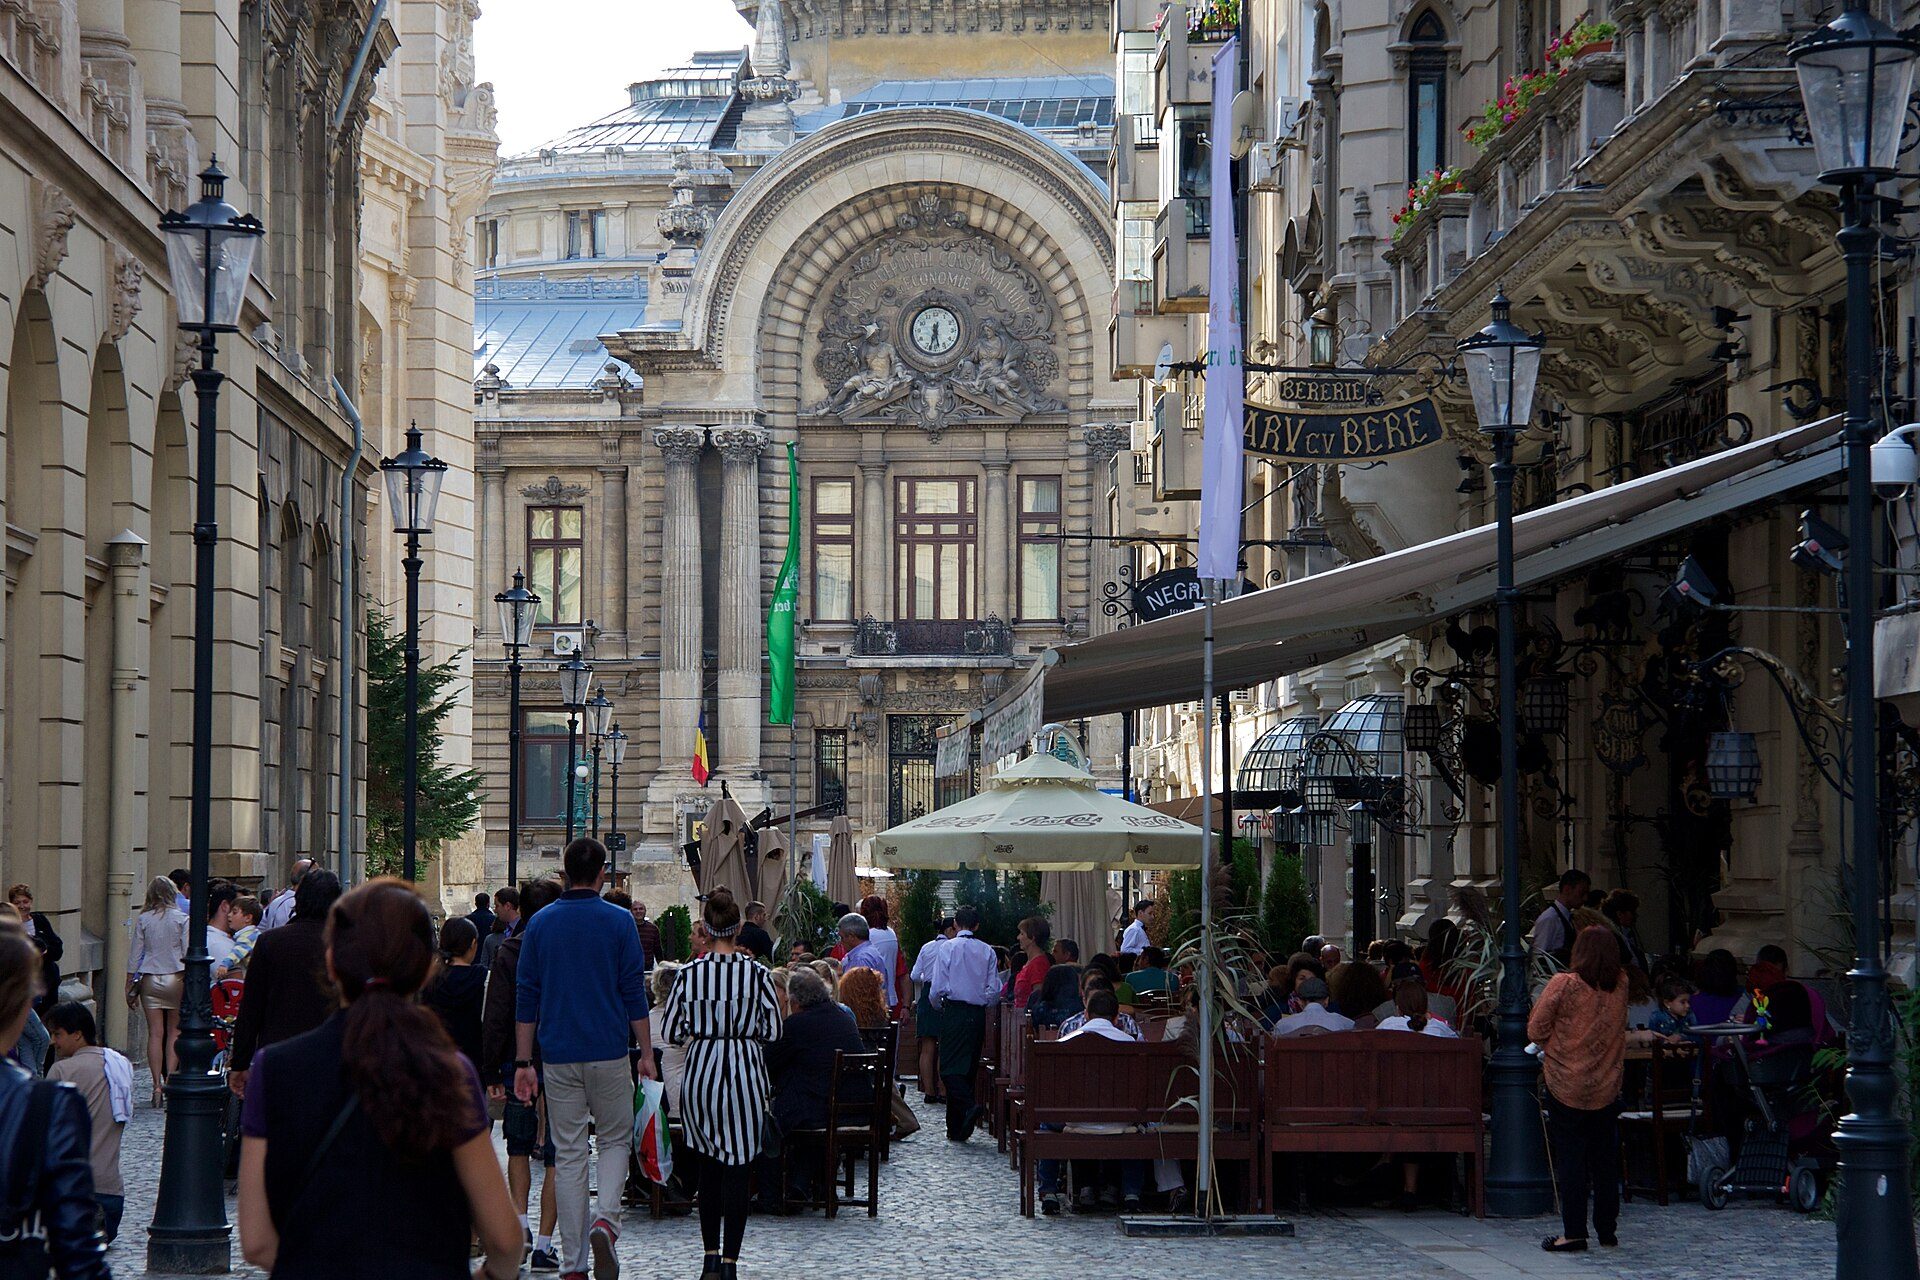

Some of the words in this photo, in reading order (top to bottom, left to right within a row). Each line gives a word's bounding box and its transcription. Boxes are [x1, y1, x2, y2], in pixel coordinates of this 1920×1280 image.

[903, 271, 972, 291] ECONOMIE
[1341, 407, 1428, 455] BERE
[1146, 582, 1204, 611] NEGR
